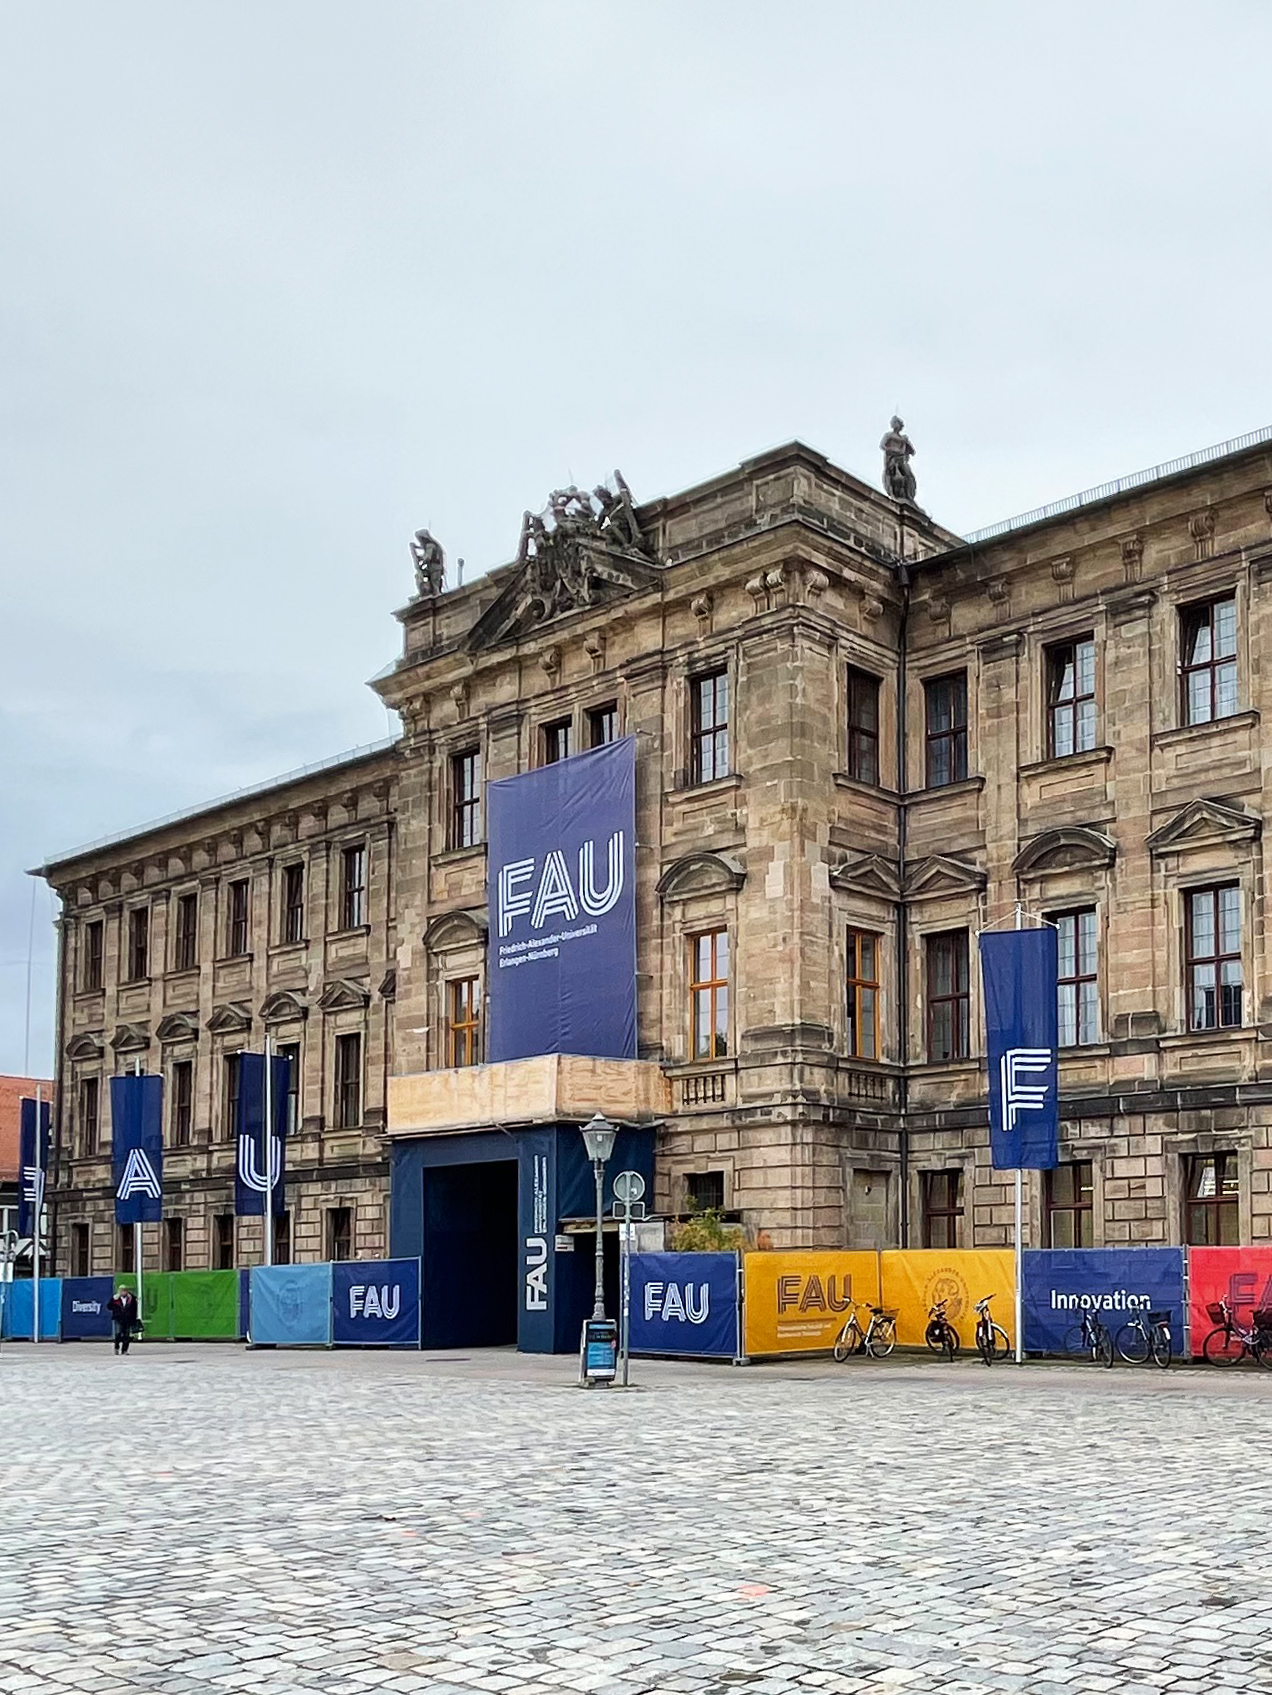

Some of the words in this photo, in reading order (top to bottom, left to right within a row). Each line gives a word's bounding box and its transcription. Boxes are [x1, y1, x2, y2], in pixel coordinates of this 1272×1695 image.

[498, 830, 625, 938] FAU
[1001, 1048, 1052, 1131] F
[116, 1148, 162, 1200] A
[238, 1134, 282, 1192] U
[526, 1236, 548, 1311] FAU
[777, 1273, 852, 1314] FAU
[72, 1300, 101, 1315] Diversity
[349, 1284, 400, 1320] FAU
[644, 1282, 709, 1325] FAU
[1051, 1289, 1151, 1310] Innovation
